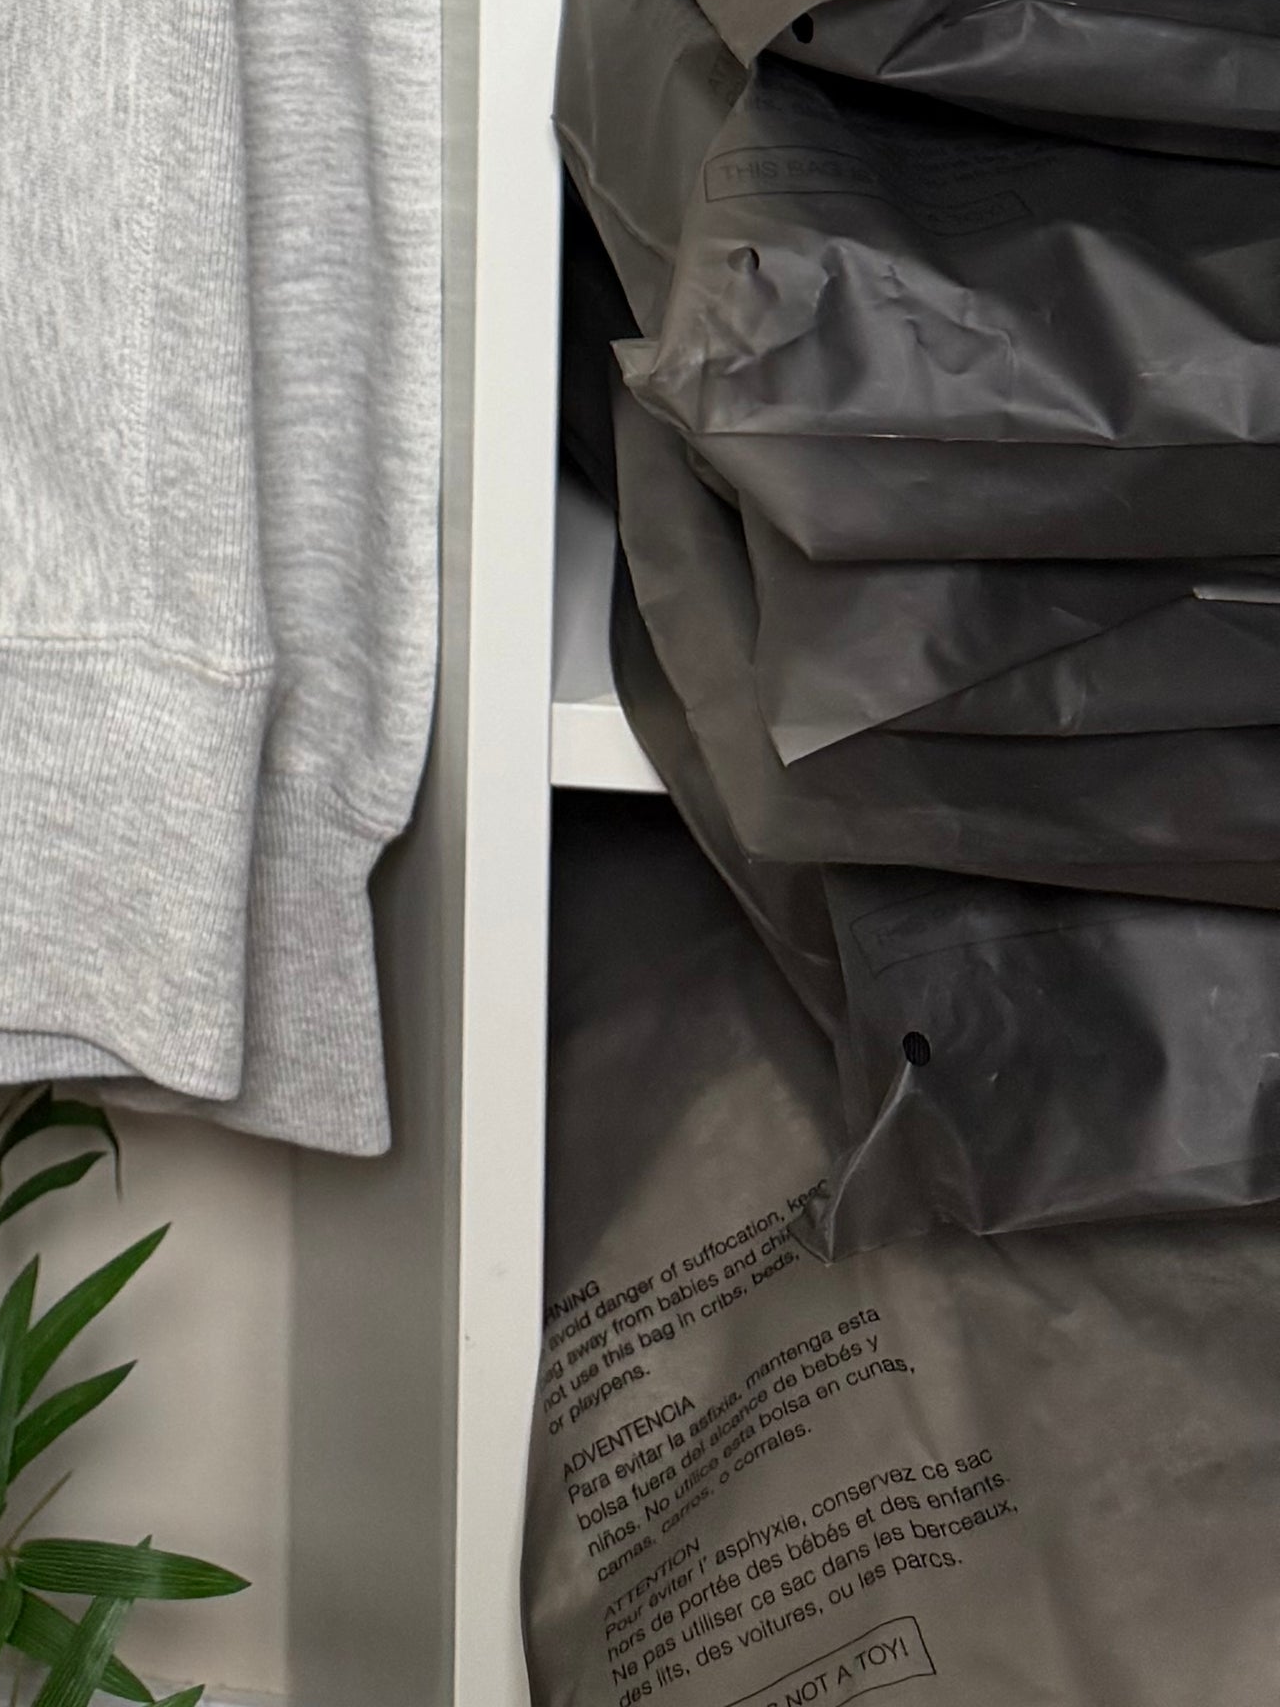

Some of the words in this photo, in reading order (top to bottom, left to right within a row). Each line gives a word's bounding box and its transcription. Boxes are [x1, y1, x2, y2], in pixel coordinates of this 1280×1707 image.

[542, 1388, 568, 1414] not
[571, 1363, 600, 1391] use
[602, 1339, 635, 1369] this
[638, 1321, 676, 1349] bag
[677, 1310, 696, 1330] in
[700, 1285, 748, 1319] cribs,
[751, 1251, 800, 1287] beds,
[548, 1311, 592, 1353] avoid
[595, 1275, 654, 1320] danger
[660, 1261, 678, 1284] of
[682, 1210, 786, 1273] suffocation,
[567, 1331, 609, 1366] away
[612, 1304, 654, 1336] from
[657, 1273, 719, 1313] babies
[723, 1251, 757, 1280] and
[548, 1414, 564, 1437] or
[568, 1363, 651, 1423] playpens.
[562, 1394, 696, 1483] ADVENTENCIA
[567, 1473, 611, 1504] Para
[615, 1441, 670, 1480] evitar
[667, 1431, 686, 1452] la
[745, 1330, 833, 1389] mantenga
[838, 1308, 881, 1335] esta
[576, 1494, 629, 1531] bolsa
[631, 1464, 677, 1501] fuera
[680, 1443, 706, 1470] del
[710, 1389, 768, 1447] alcance
[773, 1373, 798, 1394] de
[800, 1342, 863, 1380] bebés
[866, 1334, 878, 1353] y
[643, 1495, 670, 1522] No
[674, 1456, 720, 1500] utilice
[723, 1421, 757, 1460] esta
[759, 1394, 811, 1428] bolsa
[816, 1379, 840, 1400] en
[846, 1357, 915, 1387] cunas,
[719, 1471, 730, 1484] o
[733, 1422, 812, 1472] corrales.
[603, 1537, 701, 1621] ATTENTION
[605, 1604, 643, 1641] Pour
[715, 1514, 807, 1566] asphyxie,
[811, 1466, 917, 1518] conservez
[921, 1462, 950, 1481] ce
[954, 1447, 994, 1473] sac
[612, 1660, 639, 1686] Ne
[642, 1637, 677, 1669] pas
[681, 1602, 743, 1643] utiliser
[750, 1589, 775, 1611] ce
[780, 1569, 817, 1597] sac
[822, 1543, 871, 1578] dans
[874, 1525, 905, 1550] les
[909, 1499, 1019, 1539] berceaux,
[651, 1609, 674, 1632] de
[678, 1572, 741, 1618] portée
[746, 1553, 783, 1581] des
[786, 1521, 851, 1561] bébés
[855, 1507, 876, 1529] et
[880, 1493, 921, 1516] des
[926, 1471, 1011, 1510] enfants.
[619, 1680, 653, 1707] des
[656, 1662, 690, 1688] lits,
[696, 1639, 734, 1667] des
[737, 1601, 824, 1647] voitures,
[828, 1581, 854, 1605] ou
[858, 1563, 887, 1589] les
[891, 1550, 963, 1575] parcs.
[786, 1673, 830, 1707] NOT
[837, 1664, 853, 1686] A
[854, 1636, 909, 1672] TOY!
